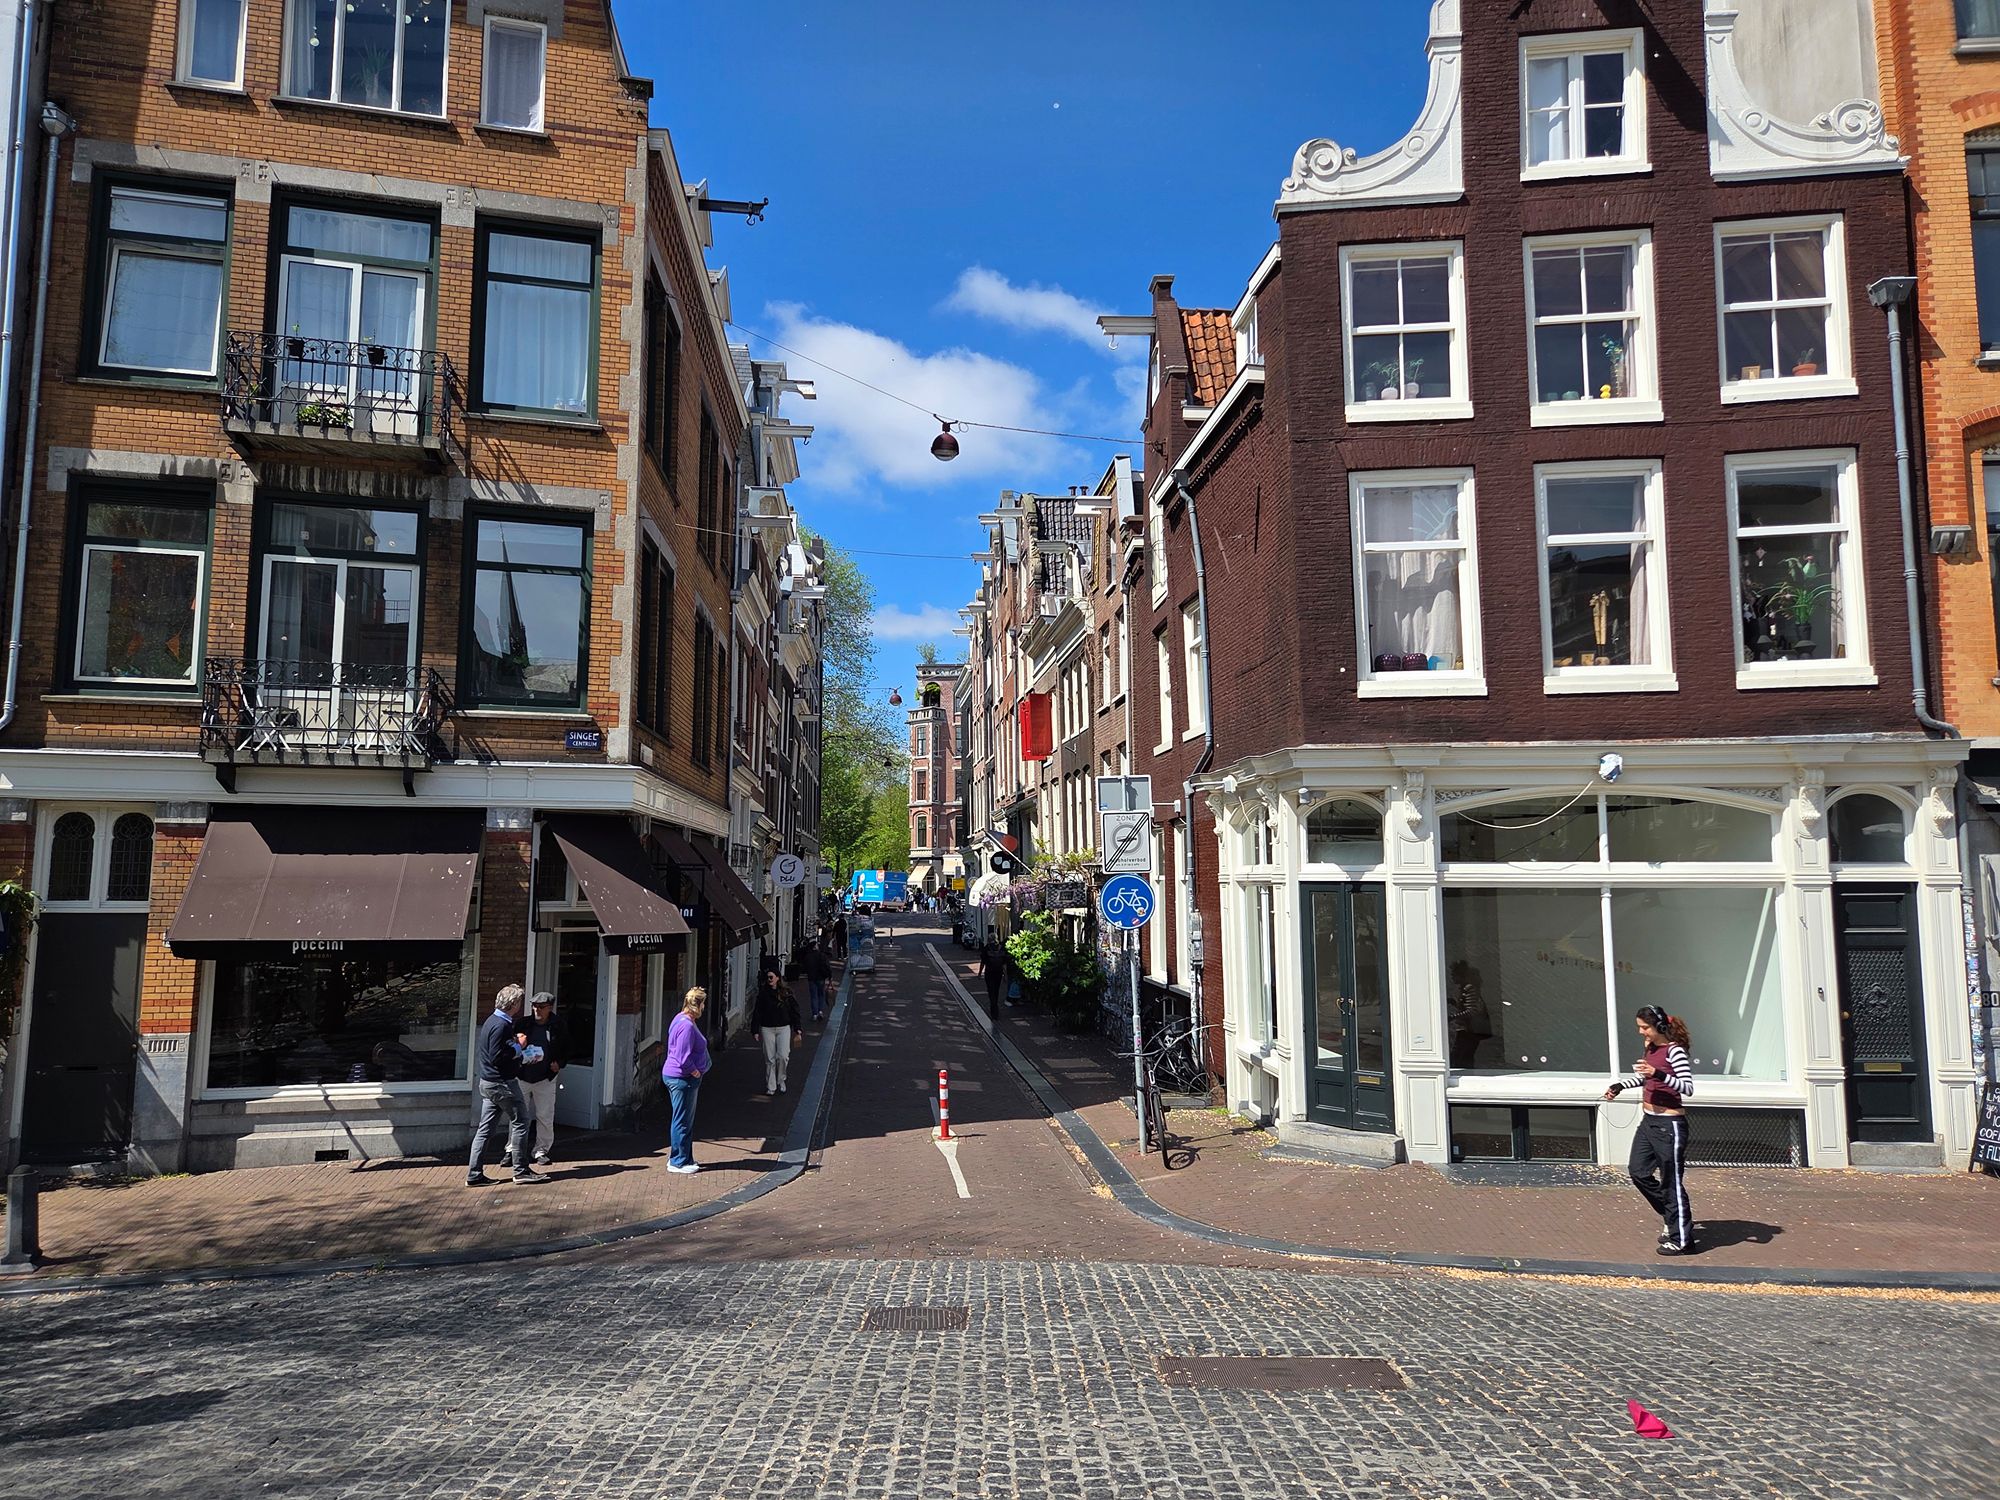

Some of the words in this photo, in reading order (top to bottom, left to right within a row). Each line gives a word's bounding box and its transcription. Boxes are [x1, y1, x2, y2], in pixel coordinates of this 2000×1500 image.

[570, 732, 599, 741] SINGEL
[292, 940, 343, 954] puccini
[627, 934, 663, 948] puccini
[1980, 1128, 2000, 1140] COF
